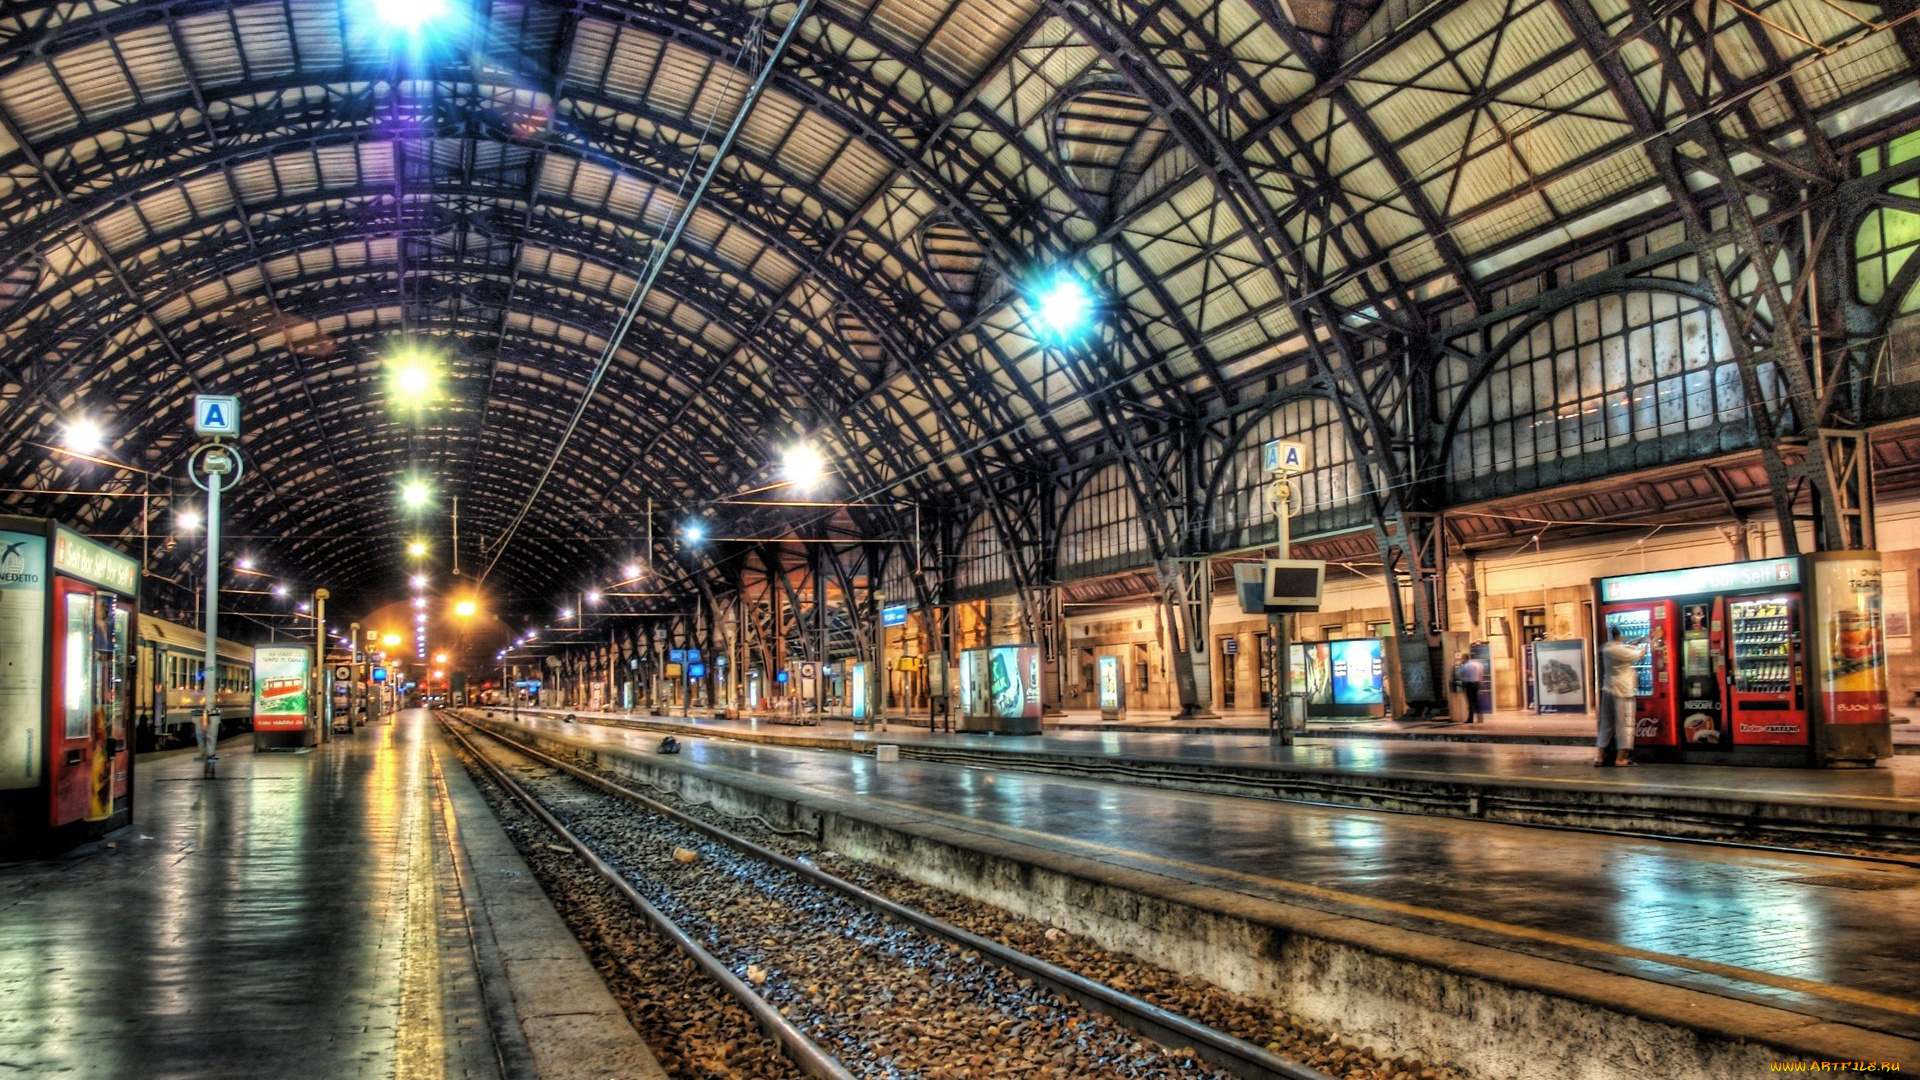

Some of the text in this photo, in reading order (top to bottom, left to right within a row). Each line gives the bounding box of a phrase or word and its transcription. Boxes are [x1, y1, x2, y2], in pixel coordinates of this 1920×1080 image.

[204, 404, 225, 426] A
[1269, 448, 1277, 466] A
[1286, 447, 1299, 465] A
[1743, 565, 1770, 584] Self
